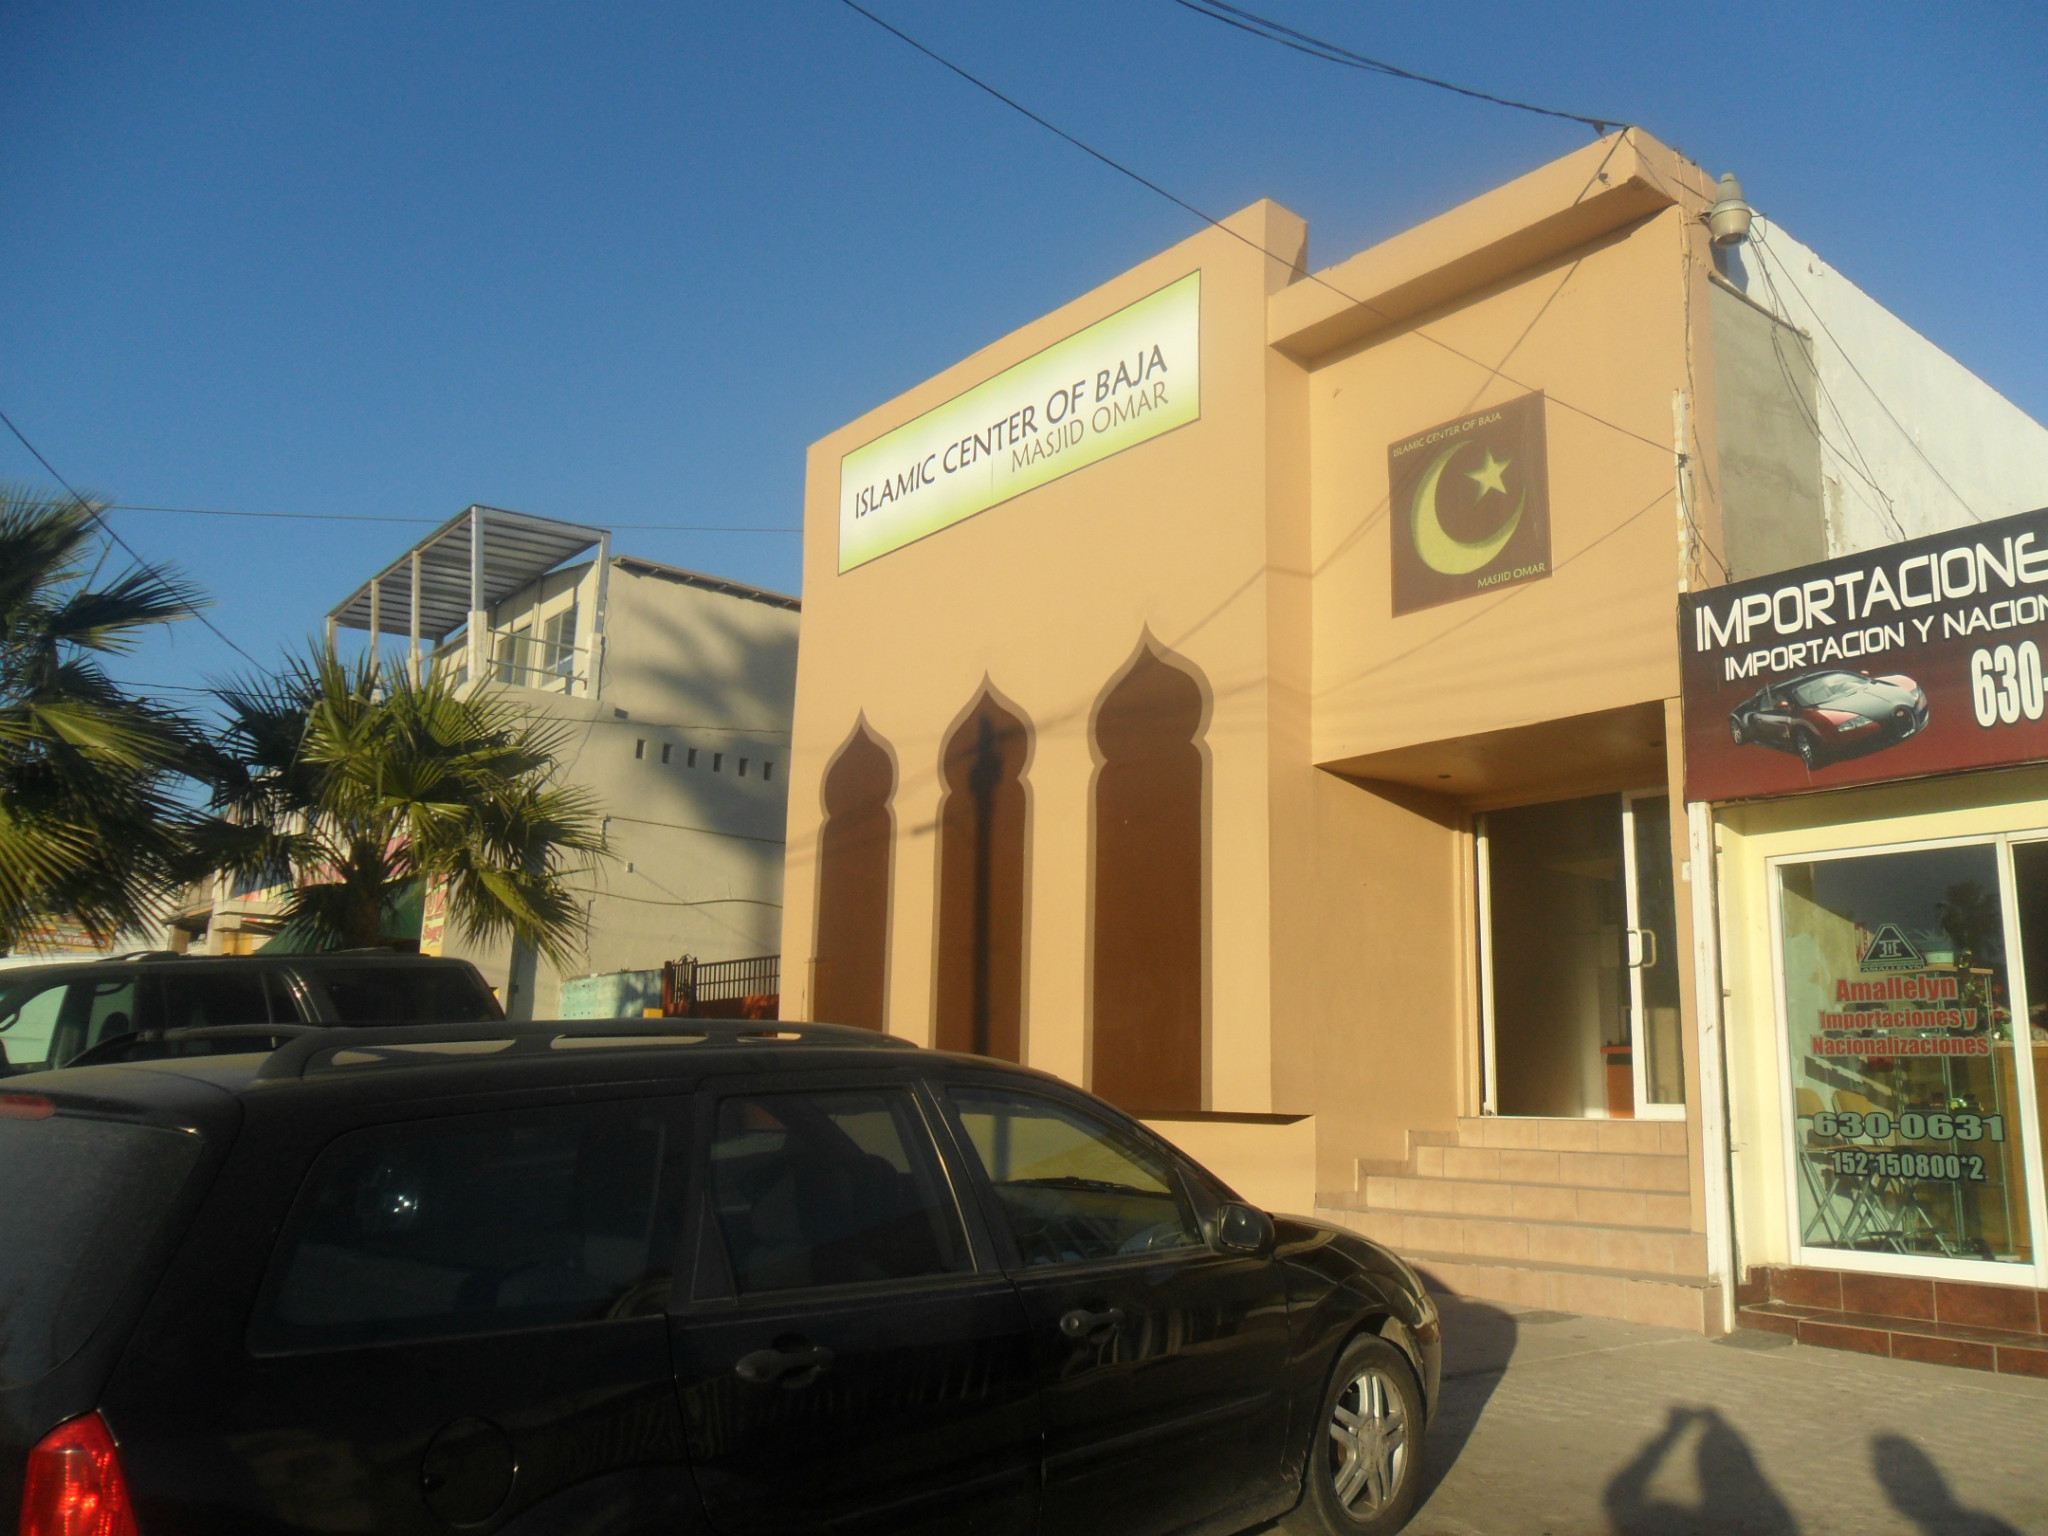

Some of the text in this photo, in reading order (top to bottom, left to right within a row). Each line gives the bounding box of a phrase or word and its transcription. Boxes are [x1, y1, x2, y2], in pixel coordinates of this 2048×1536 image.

[855, 344, 1168, 519] ISLAMIC CENTER OF BAJA
[1011, 381, 1169, 473] MASJID OMAR
[1393, 411, 1502, 457] ISLAMIC CENTER OF BAJA
[1477, 563, 1546, 588] MASJID OMAR
[1695, 532, 2048, 652] IMPORTACIONE
[1725, 621, 1906, 681] IMPORTACION
[1912, 615, 1935, 644] Y
[1836, 975, 1957, 1002] Amallelyn
[1820, 1009, 1977, 1030] Importaciones y
[1812, 1036, 1990, 1056] Nacionalizaciones
[1813, 1112, 2005, 1142] 630-0631
